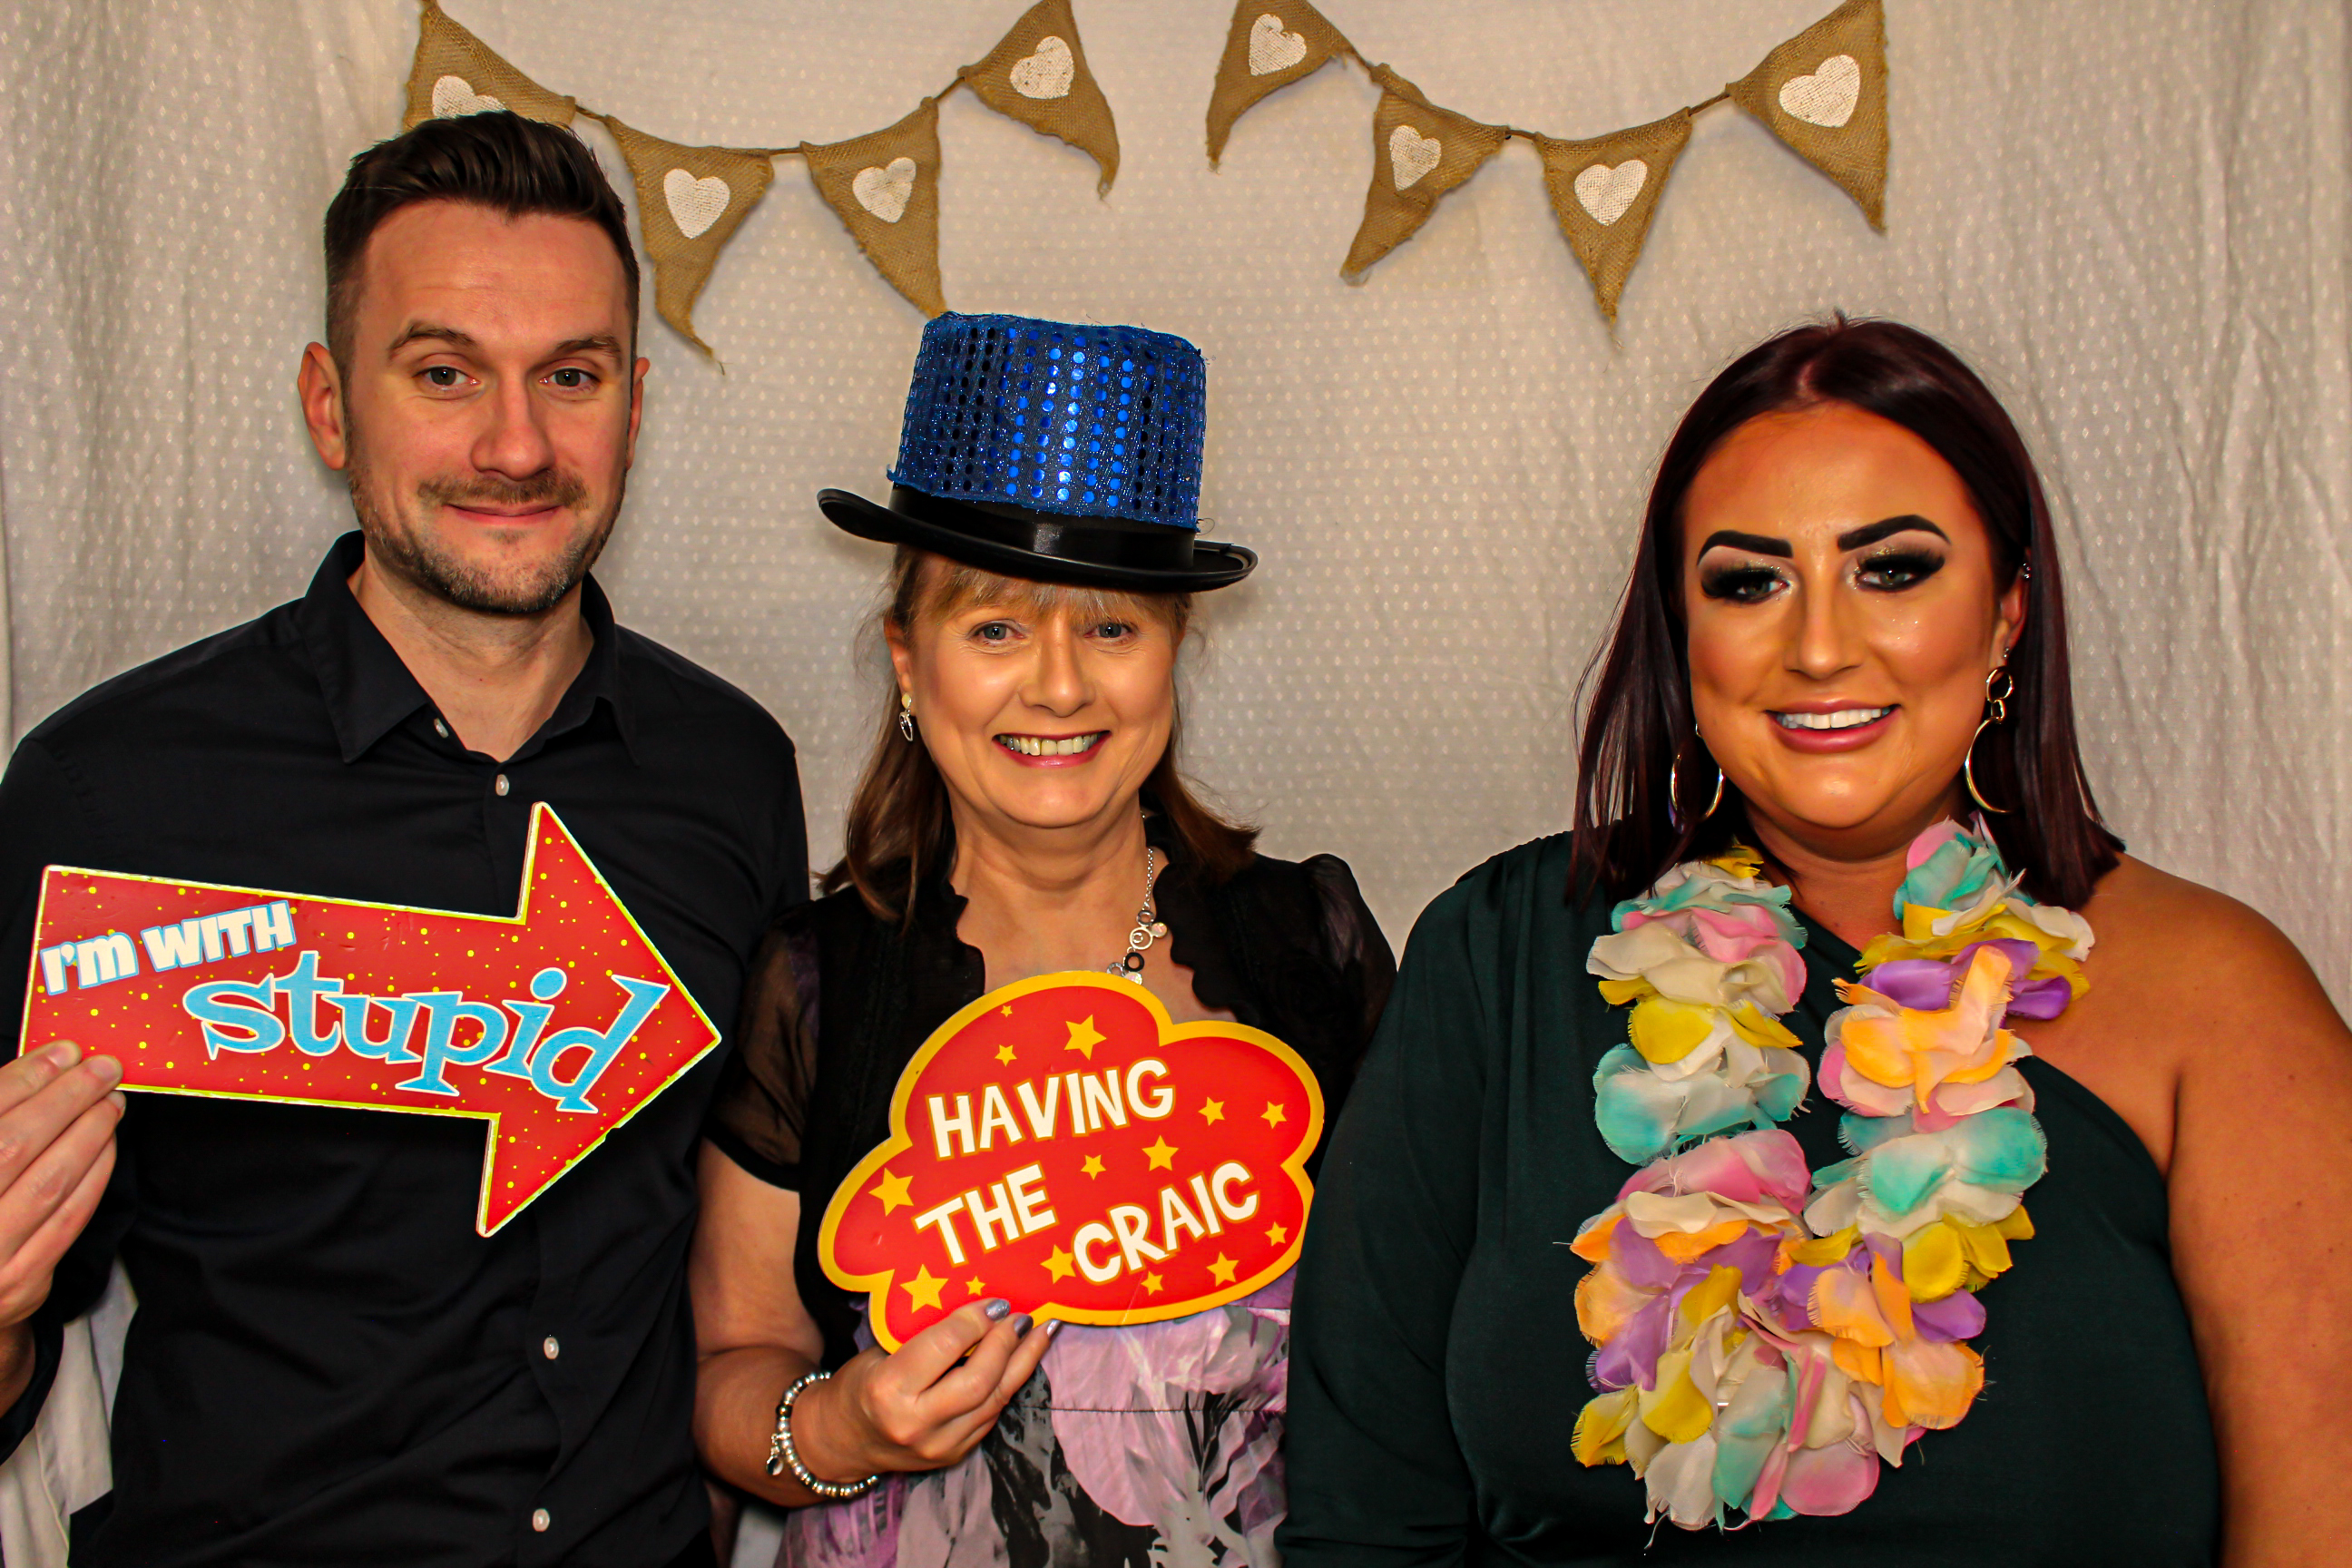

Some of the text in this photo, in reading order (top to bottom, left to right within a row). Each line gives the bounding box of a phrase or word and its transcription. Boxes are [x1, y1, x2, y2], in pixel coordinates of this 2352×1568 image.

[142, 900, 297, 972] WITH
[927, 1057, 1176, 1161] HAVING
[914, 1161, 1059, 1268] THE
[1072, 1160, 1259, 1284] CRAIC
